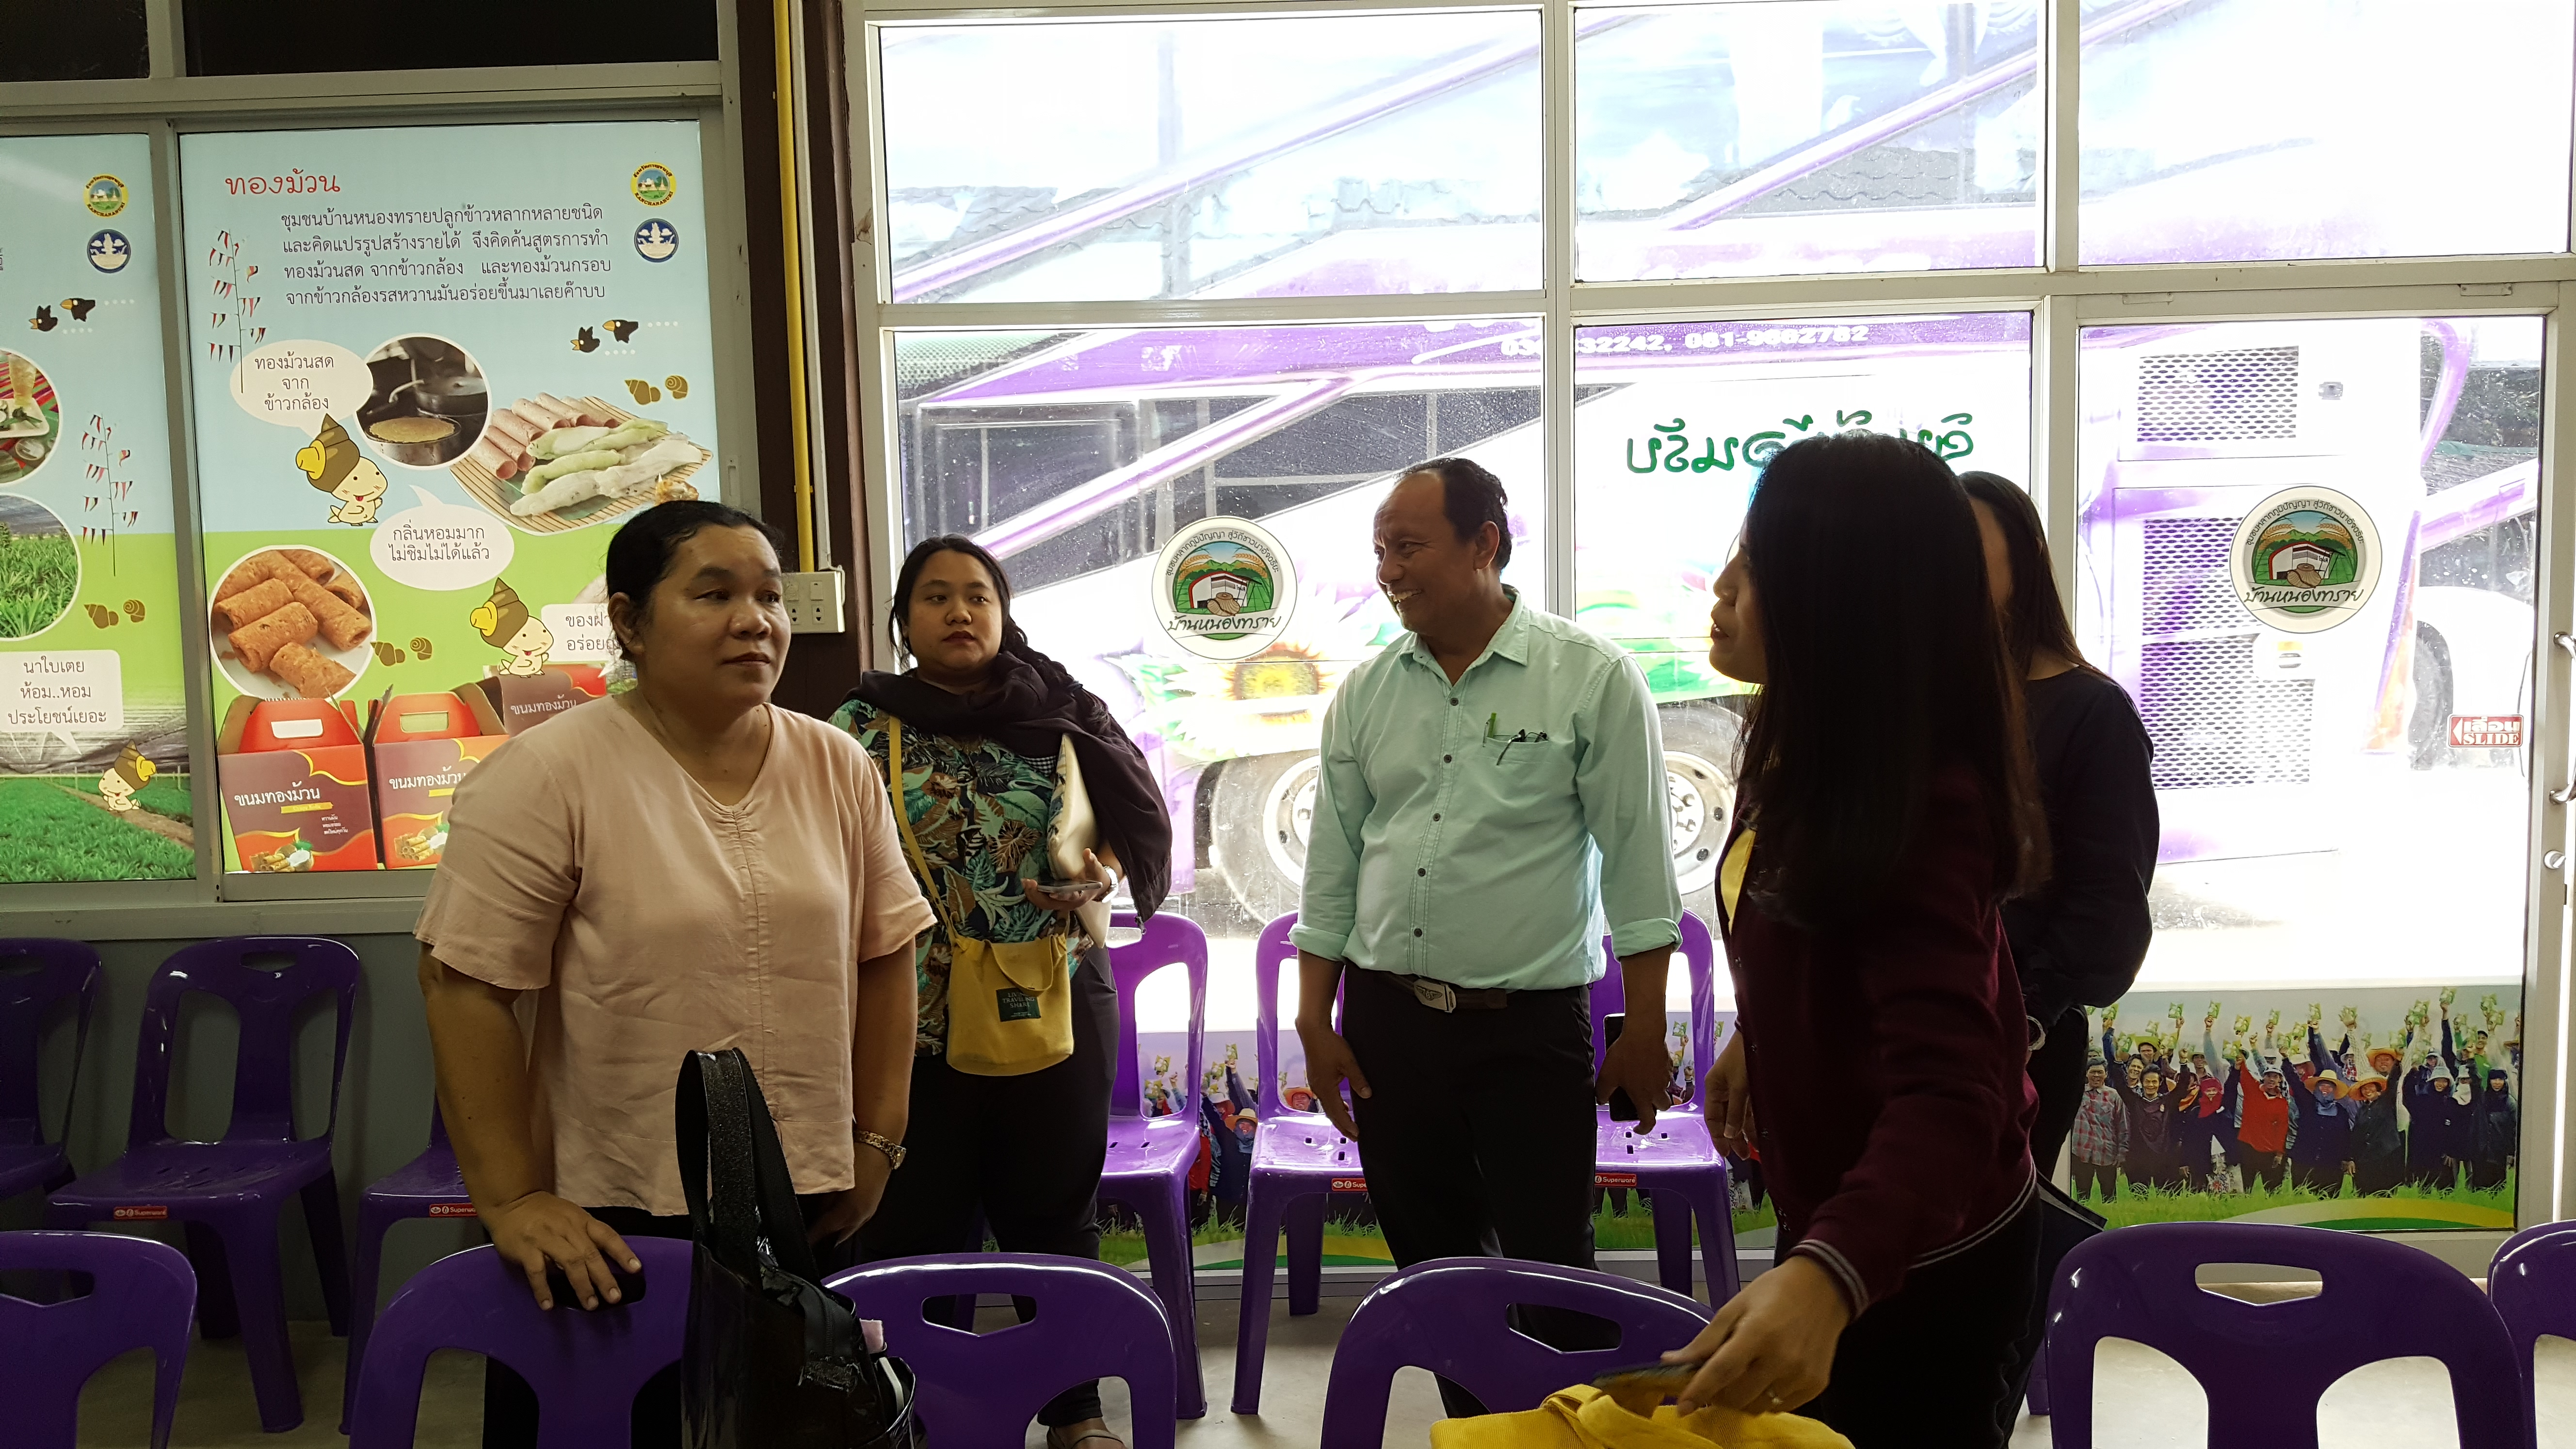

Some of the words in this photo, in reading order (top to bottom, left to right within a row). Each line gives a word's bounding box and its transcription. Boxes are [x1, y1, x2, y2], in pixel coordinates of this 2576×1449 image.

[225, 168, 340, 194] ทองม้วน
[281, 203, 603, 233] ชุมชนบ้านหนองทรายปลูกข้าวหลากหลายชนิด
[283, 230, 461, 257] และคิดแปรรูปสร้างรายได้
[472, 228, 608, 253] จึงคิดค้นสูตรการทำ
[284, 259, 364, 279] ทองม้วนสด
[370, 257, 463, 276] จากข้าวกล้อง
[482, 254, 611, 274] และทองม้วนกรอบ
[255, 351, 334, 370] ทองม้วนสด
[282, 378, 309, 390] จาก
[264, 392, 329, 411] ข้าวกล้อง
[393, 519, 484, 541] กลิ่นหอมมาก
[387, 542, 490, 561] ไม่ชิมไม่ได้แล้ว
[2243, 586, 2365, 603] บ้านหนองทราย
[1167, 615, 1282, 631] บ้านหนองทราย
[23, 655, 84, 673] นาใบเตย
[8, 705, 107, 724] ประโยชน์เยอะ
[2463, 716, 2520, 732] เลื่อน
[2463, 732, 2519, 745] SLIDE
[234, 781, 321, 806] ขนมทองม้วน
